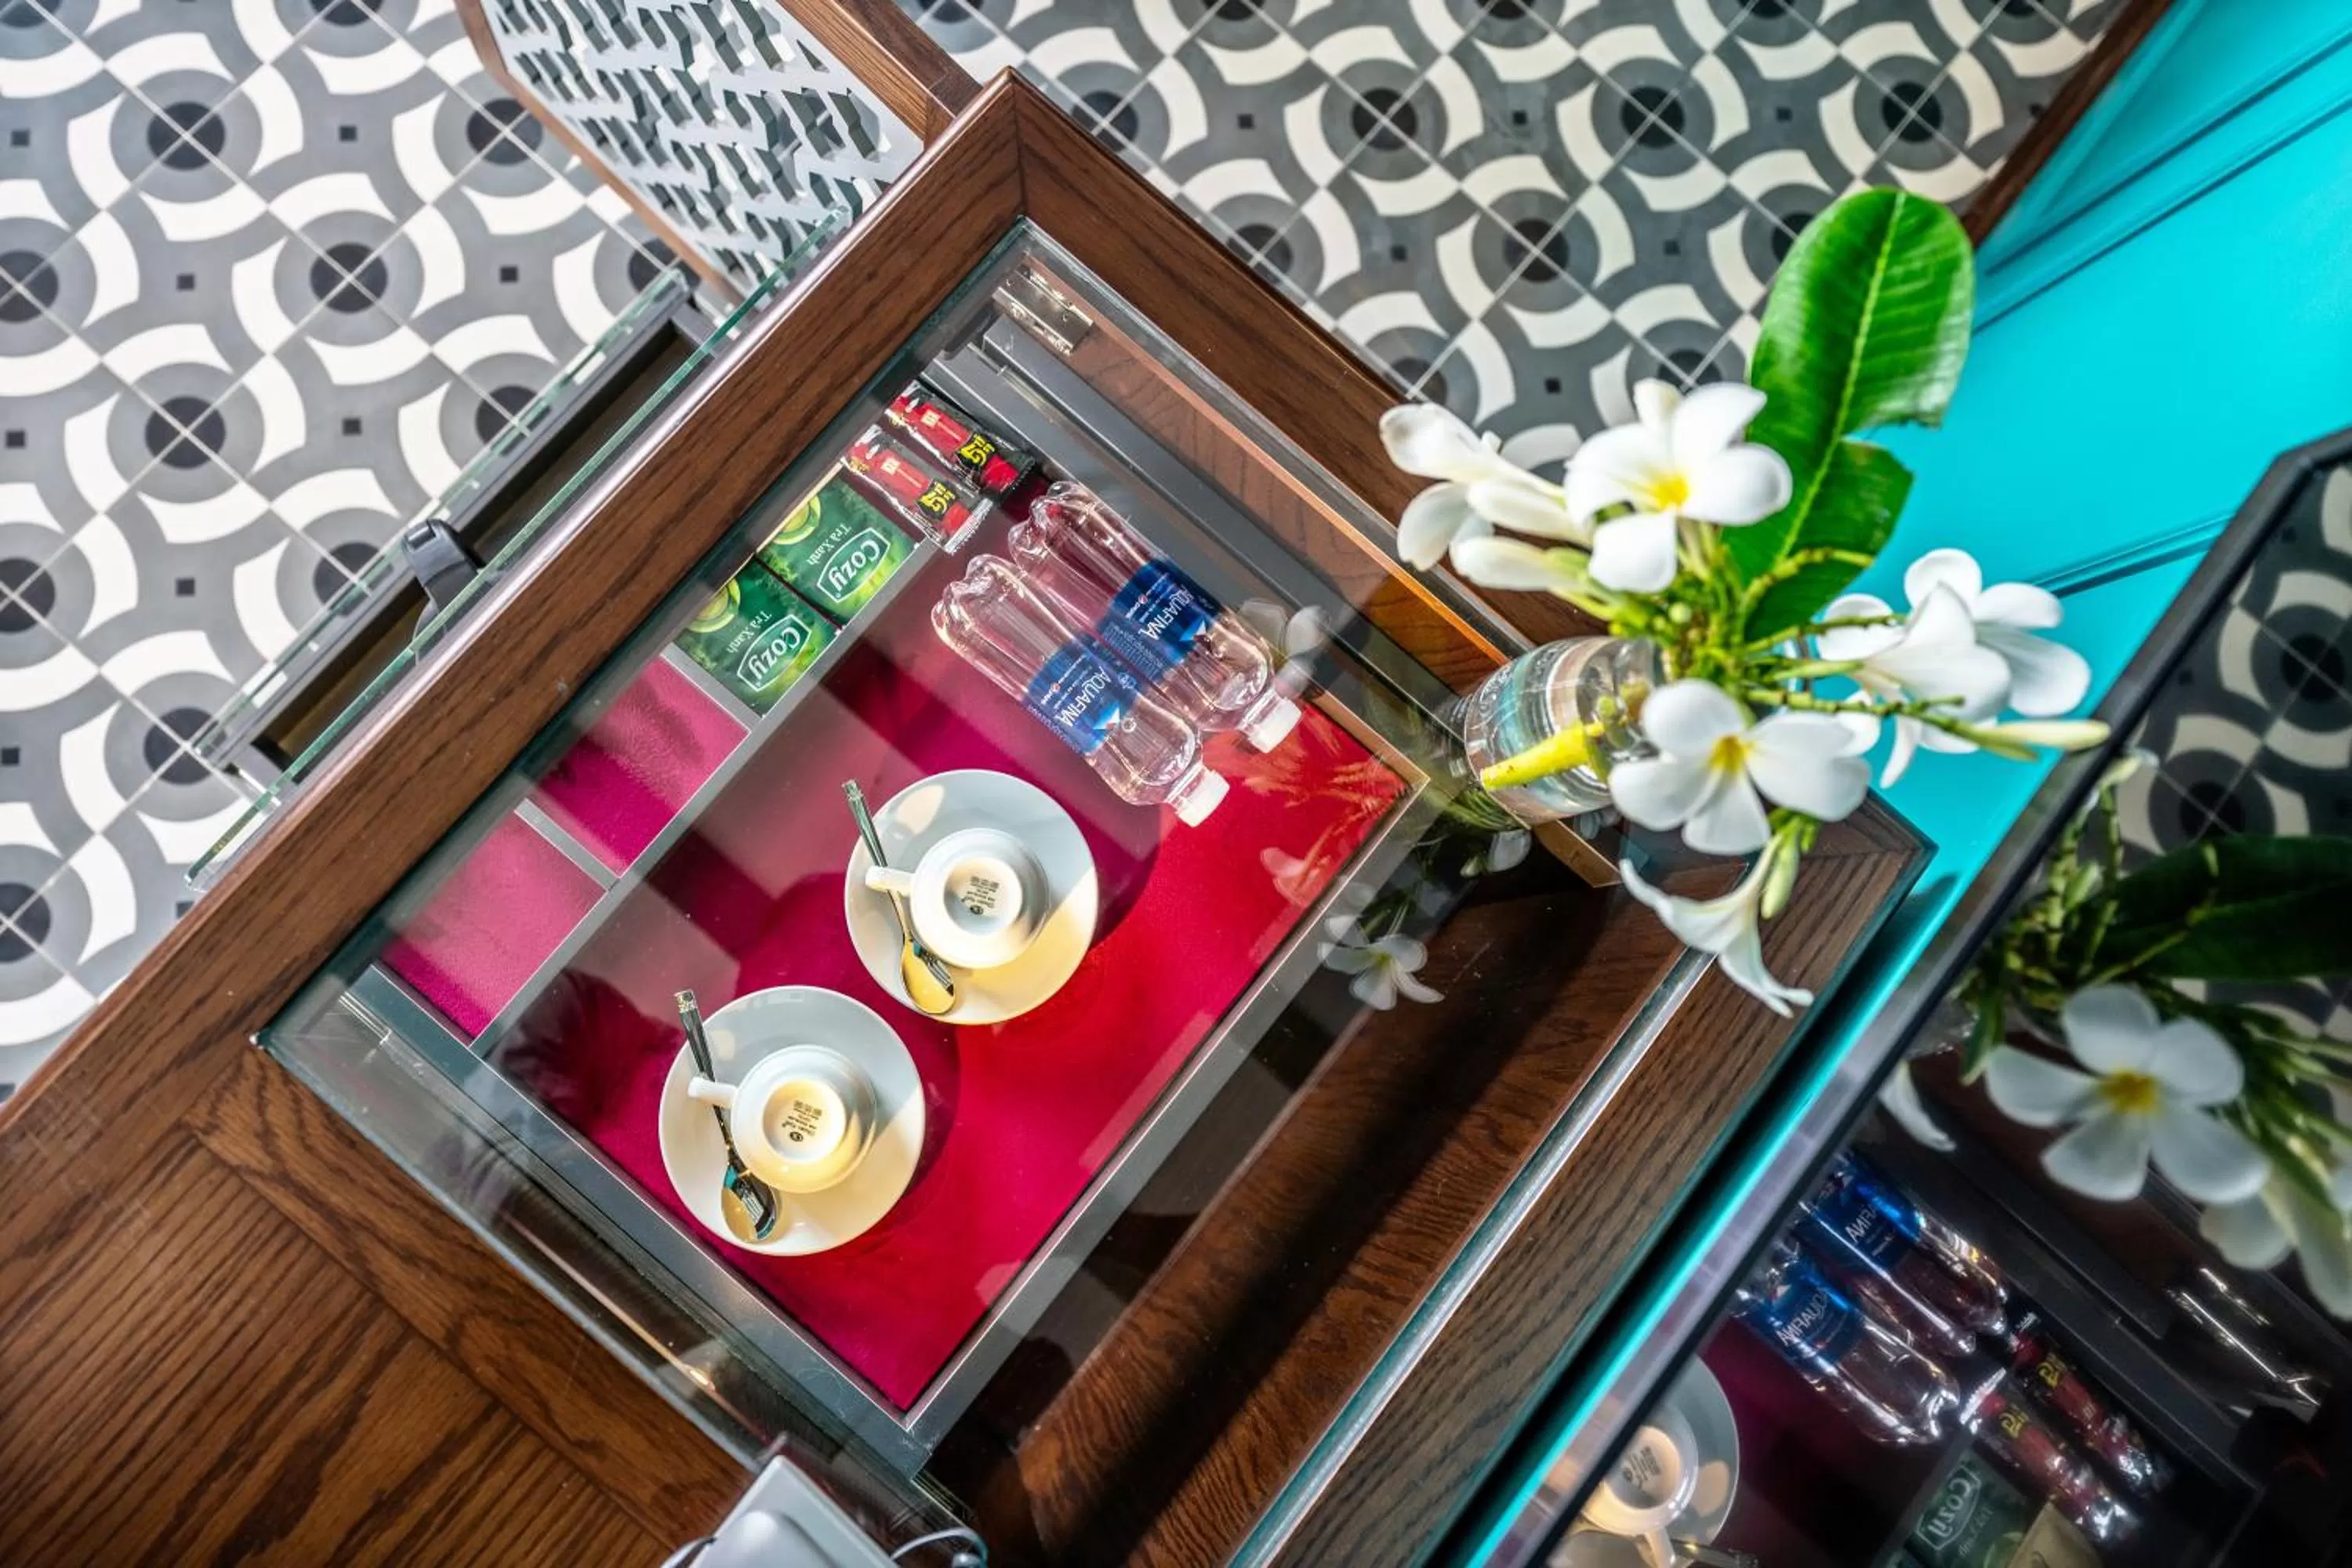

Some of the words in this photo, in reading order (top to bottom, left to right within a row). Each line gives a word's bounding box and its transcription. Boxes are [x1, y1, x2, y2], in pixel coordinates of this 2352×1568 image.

[807, 539, 834, 565] Xanh
[828, 539, 880, 592] Cozy
[727, 626, 755, 654] Xanh
[1138, 585, 1194, 641] AQUAFINA
[748, 626, 801, 681] Cozy
[1054, 666, 1112, 727] AQUAFINA
